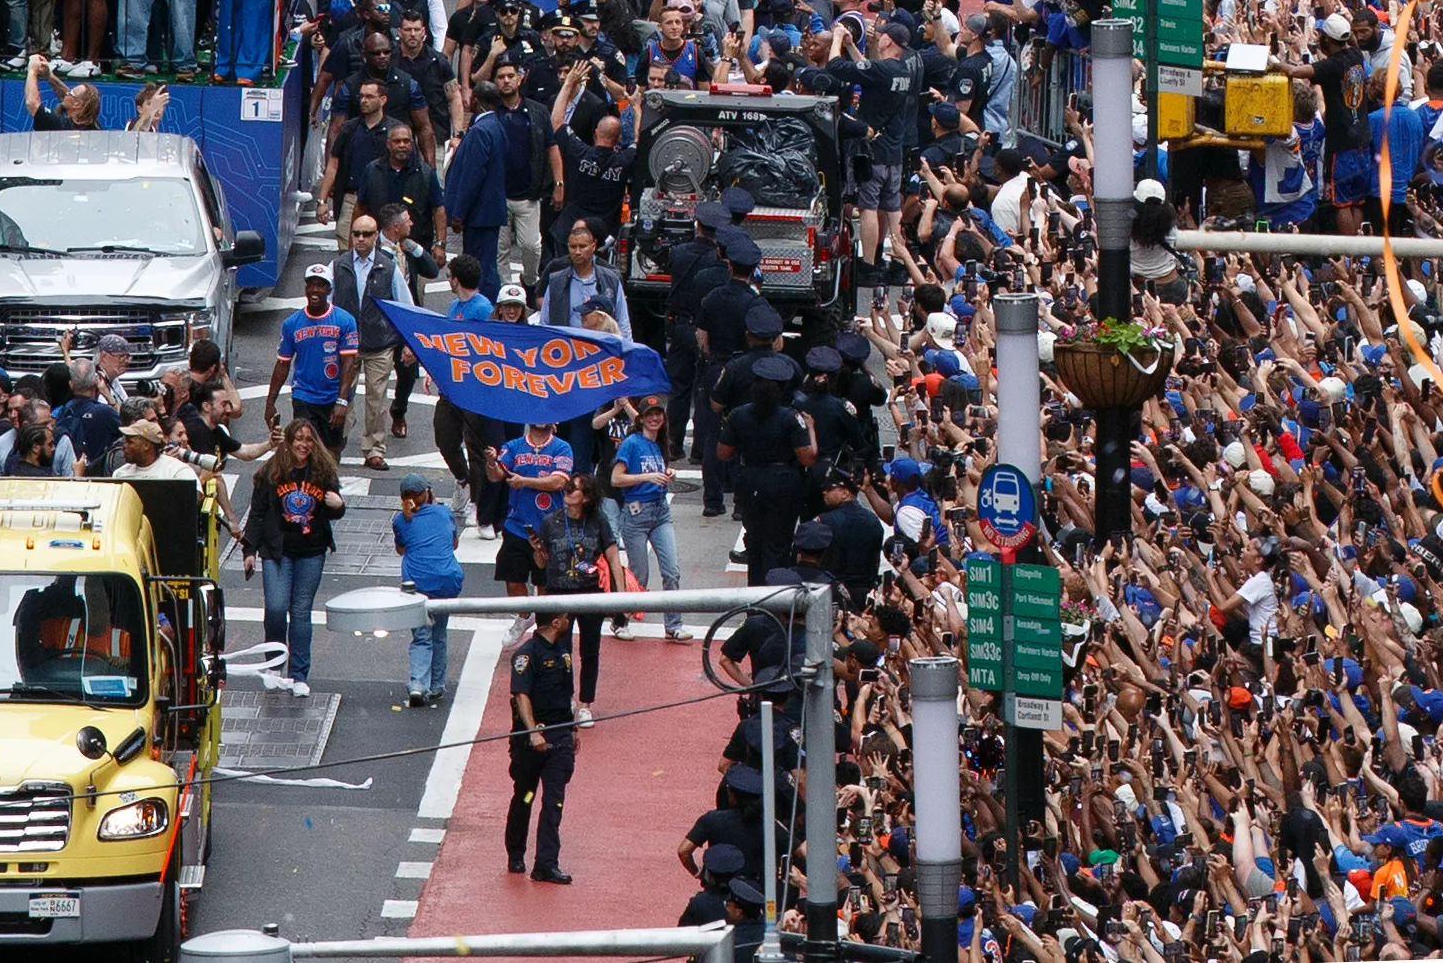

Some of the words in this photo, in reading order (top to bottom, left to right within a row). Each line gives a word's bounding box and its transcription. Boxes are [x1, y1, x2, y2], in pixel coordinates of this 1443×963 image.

[1160, 68, 1186, 79] Broadway
[253, 101, 260, 117] 1
[717, 110, 738, 120] ATV
[293, 327, 313, 343] NEW
[315, 325, 341, 338] YORK
[415, 331, 509, 360] NEW
[515, 333, 603, 373] YOR
[449, 355, 628, 400] FOREVER
[515, 454, 534, 467] NEW
[535, 455, 554, 468] YORK
[983, 525, 993, 538] NO
[996, 528, 1030, 547] STANDING
[969, 565, 992, 584] SIM1
[969, 591, 999, 611] SIM3c
[1015, 593, 1027, 603] Port
[1027, 594, 1054, 607] Richmond
[970, 617, 994, 635] SIM4
[970, 642, 1002, 662] SIM33c
[970, 668, 996, 685] MTA
[1017, 671, 1030, 682] Drop
[1040, 673, 1052, 684] Only
[1017, 699, 1044, 712] Broadway
